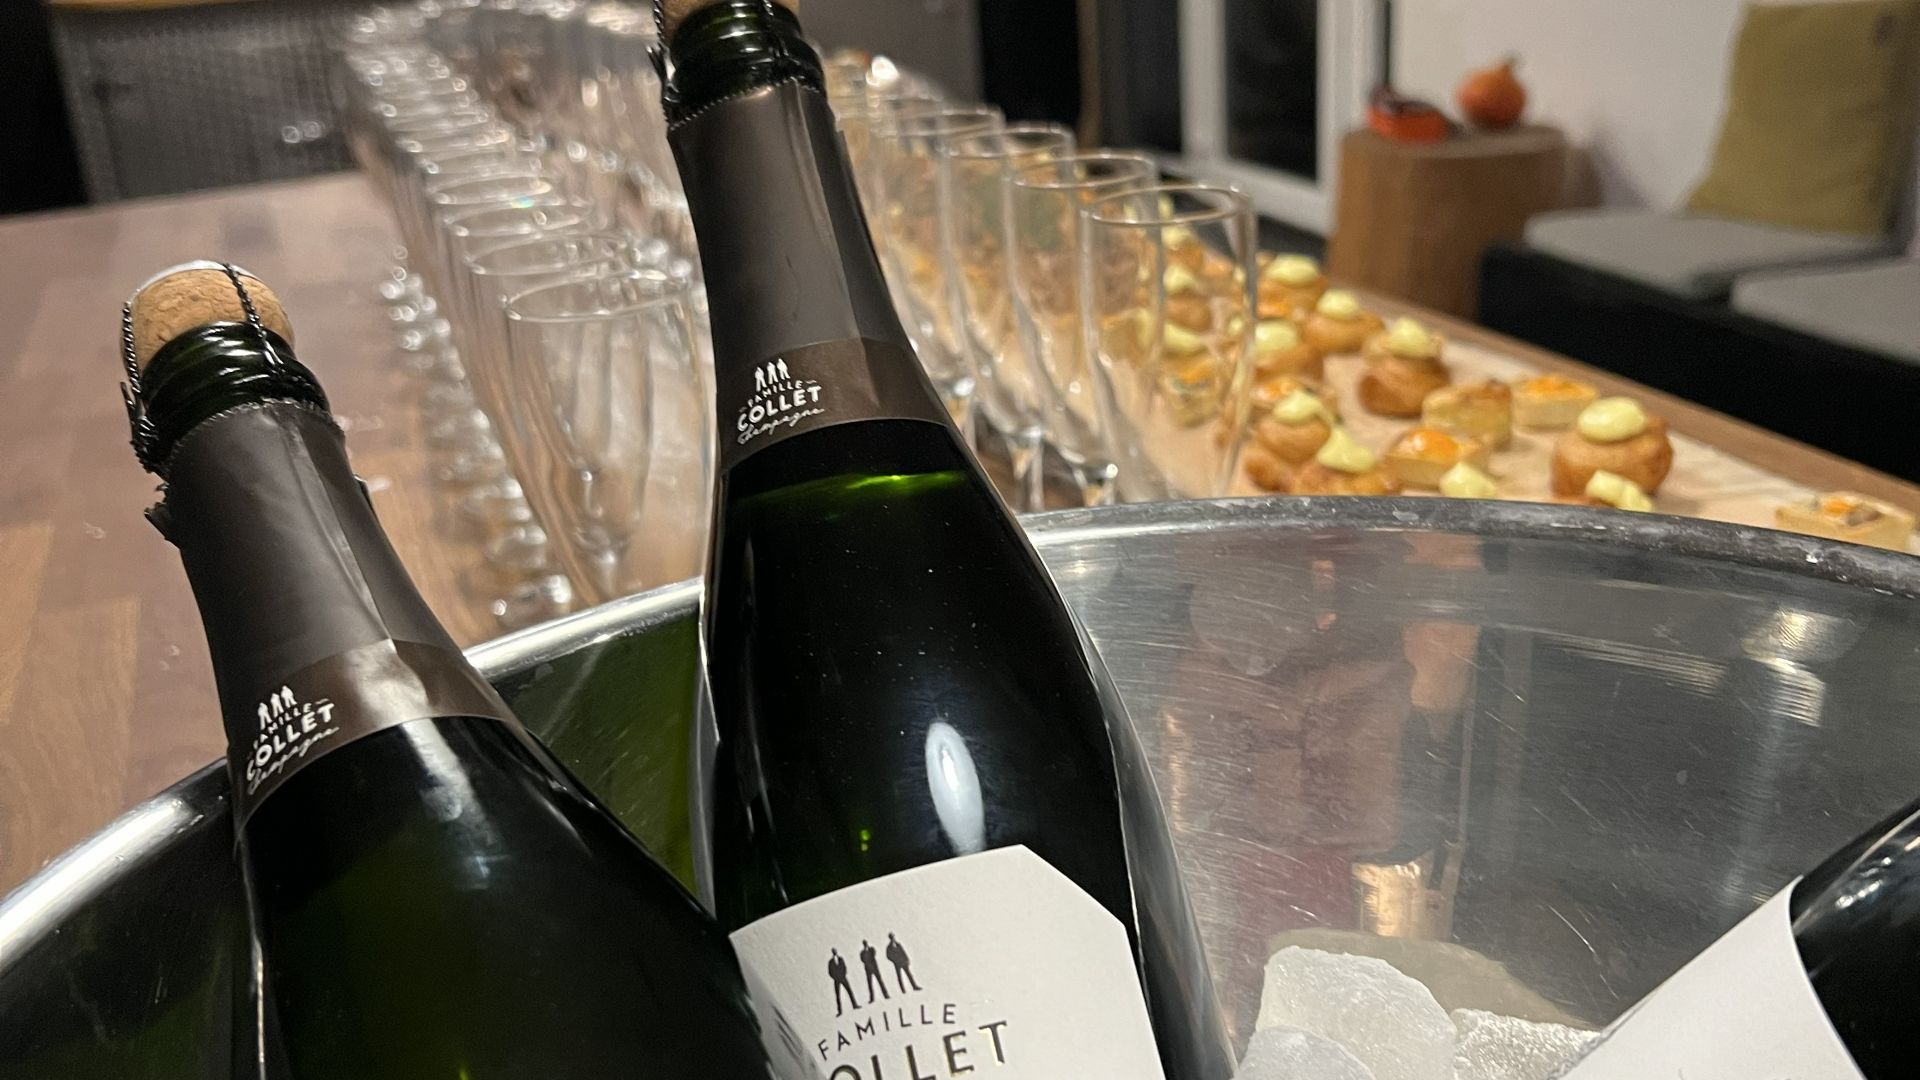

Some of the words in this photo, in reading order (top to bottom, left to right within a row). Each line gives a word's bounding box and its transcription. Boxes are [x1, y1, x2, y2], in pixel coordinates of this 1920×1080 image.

[737, 385, 822, 432] COLLET
[246, 703, 335, 781] COLLET
[817, 1003, 957, 1062] FAMILLE
[829, 1020, 1008, 1080] LLET
